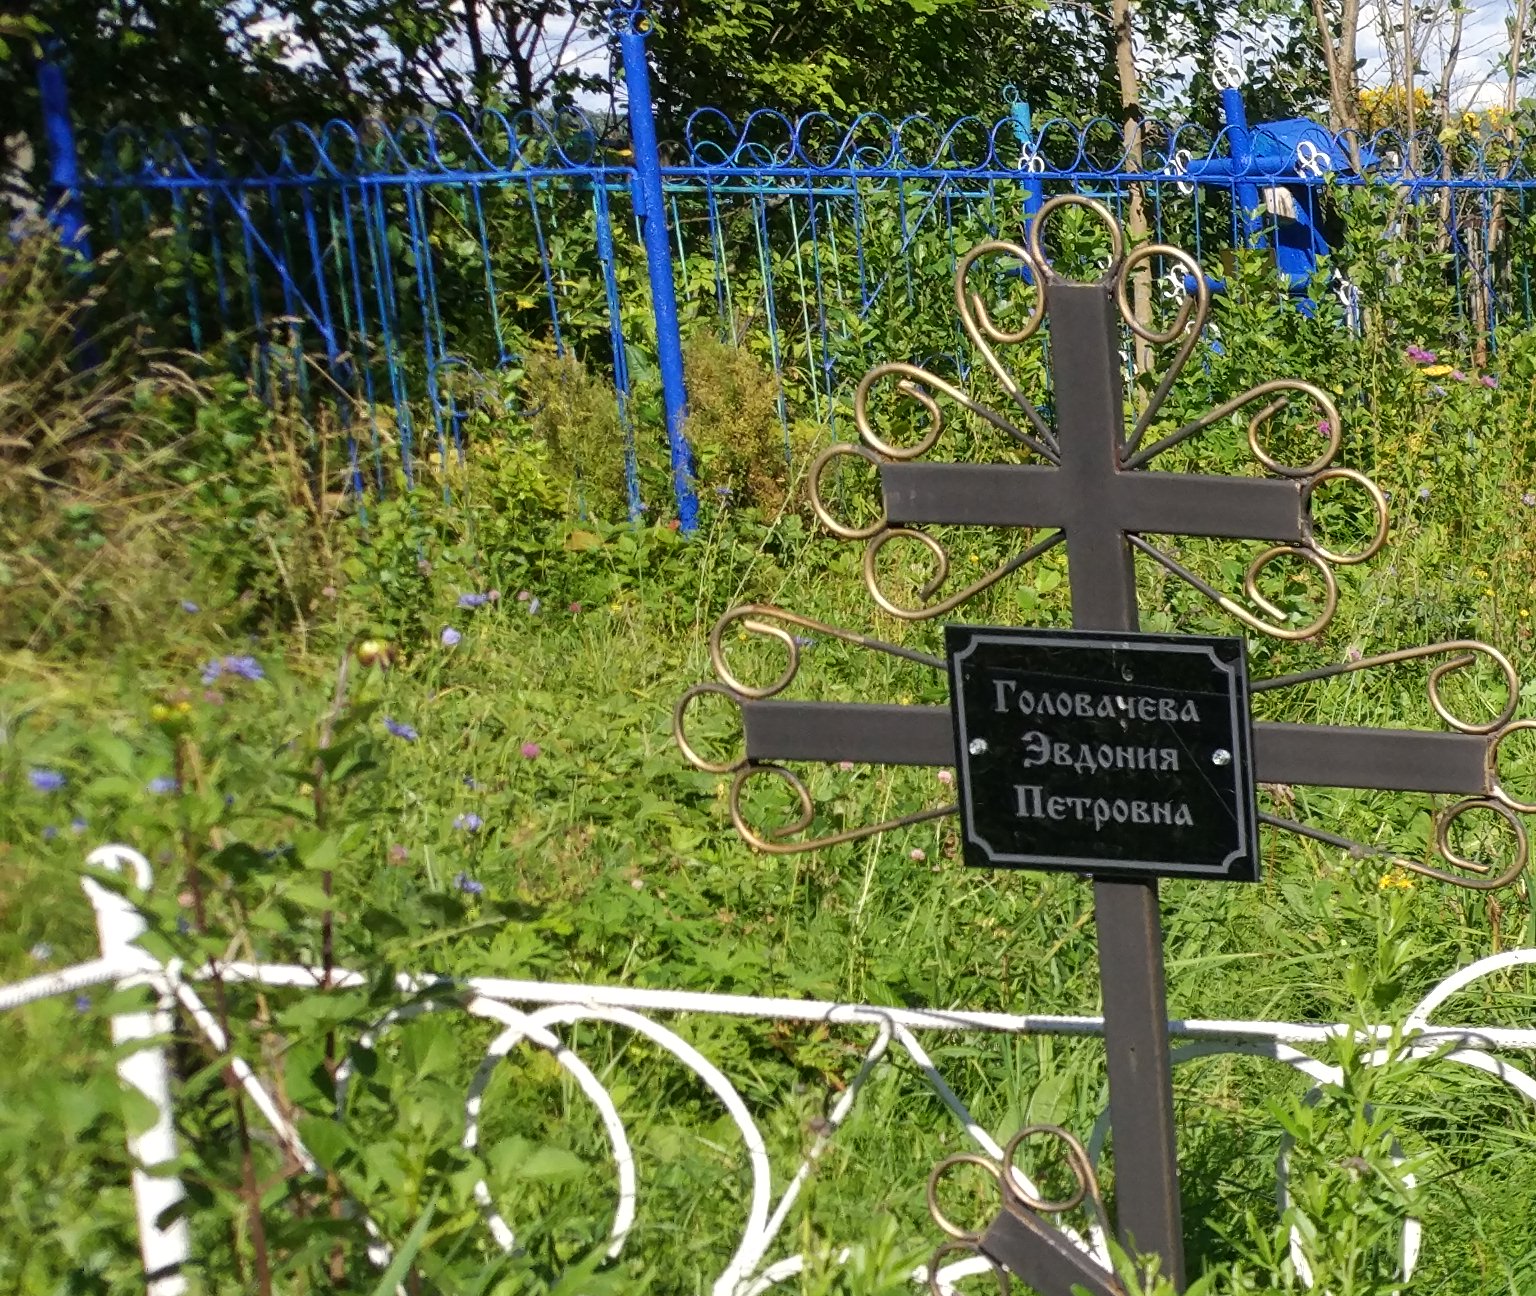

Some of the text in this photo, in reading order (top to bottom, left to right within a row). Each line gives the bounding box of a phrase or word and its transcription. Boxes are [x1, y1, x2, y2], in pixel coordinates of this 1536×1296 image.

[993, 679, 1201, 723] Головачева
[1021, 730, 1180, 775] Эвдония
[1013, 784, 1195, 831] Петровна
